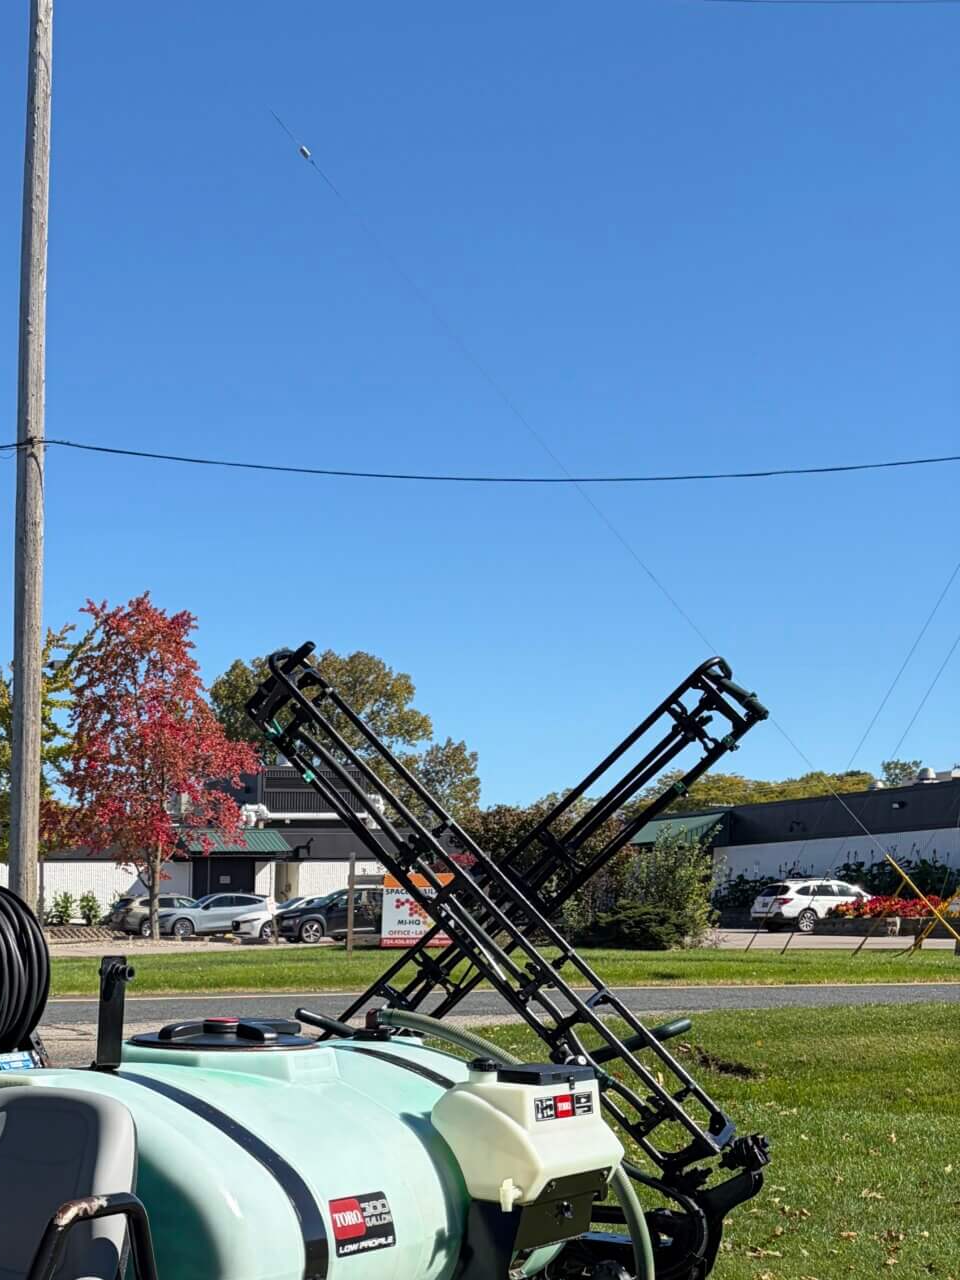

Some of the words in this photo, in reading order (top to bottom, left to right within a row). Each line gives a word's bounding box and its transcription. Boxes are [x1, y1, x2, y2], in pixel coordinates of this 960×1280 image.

[360, 1199, 390, 1216] 300
[333, 1209, 362, 1228] TORO
[339, 1243, 359, 1254] LOW
[360, 1235, 393, 1248] PROFILE
